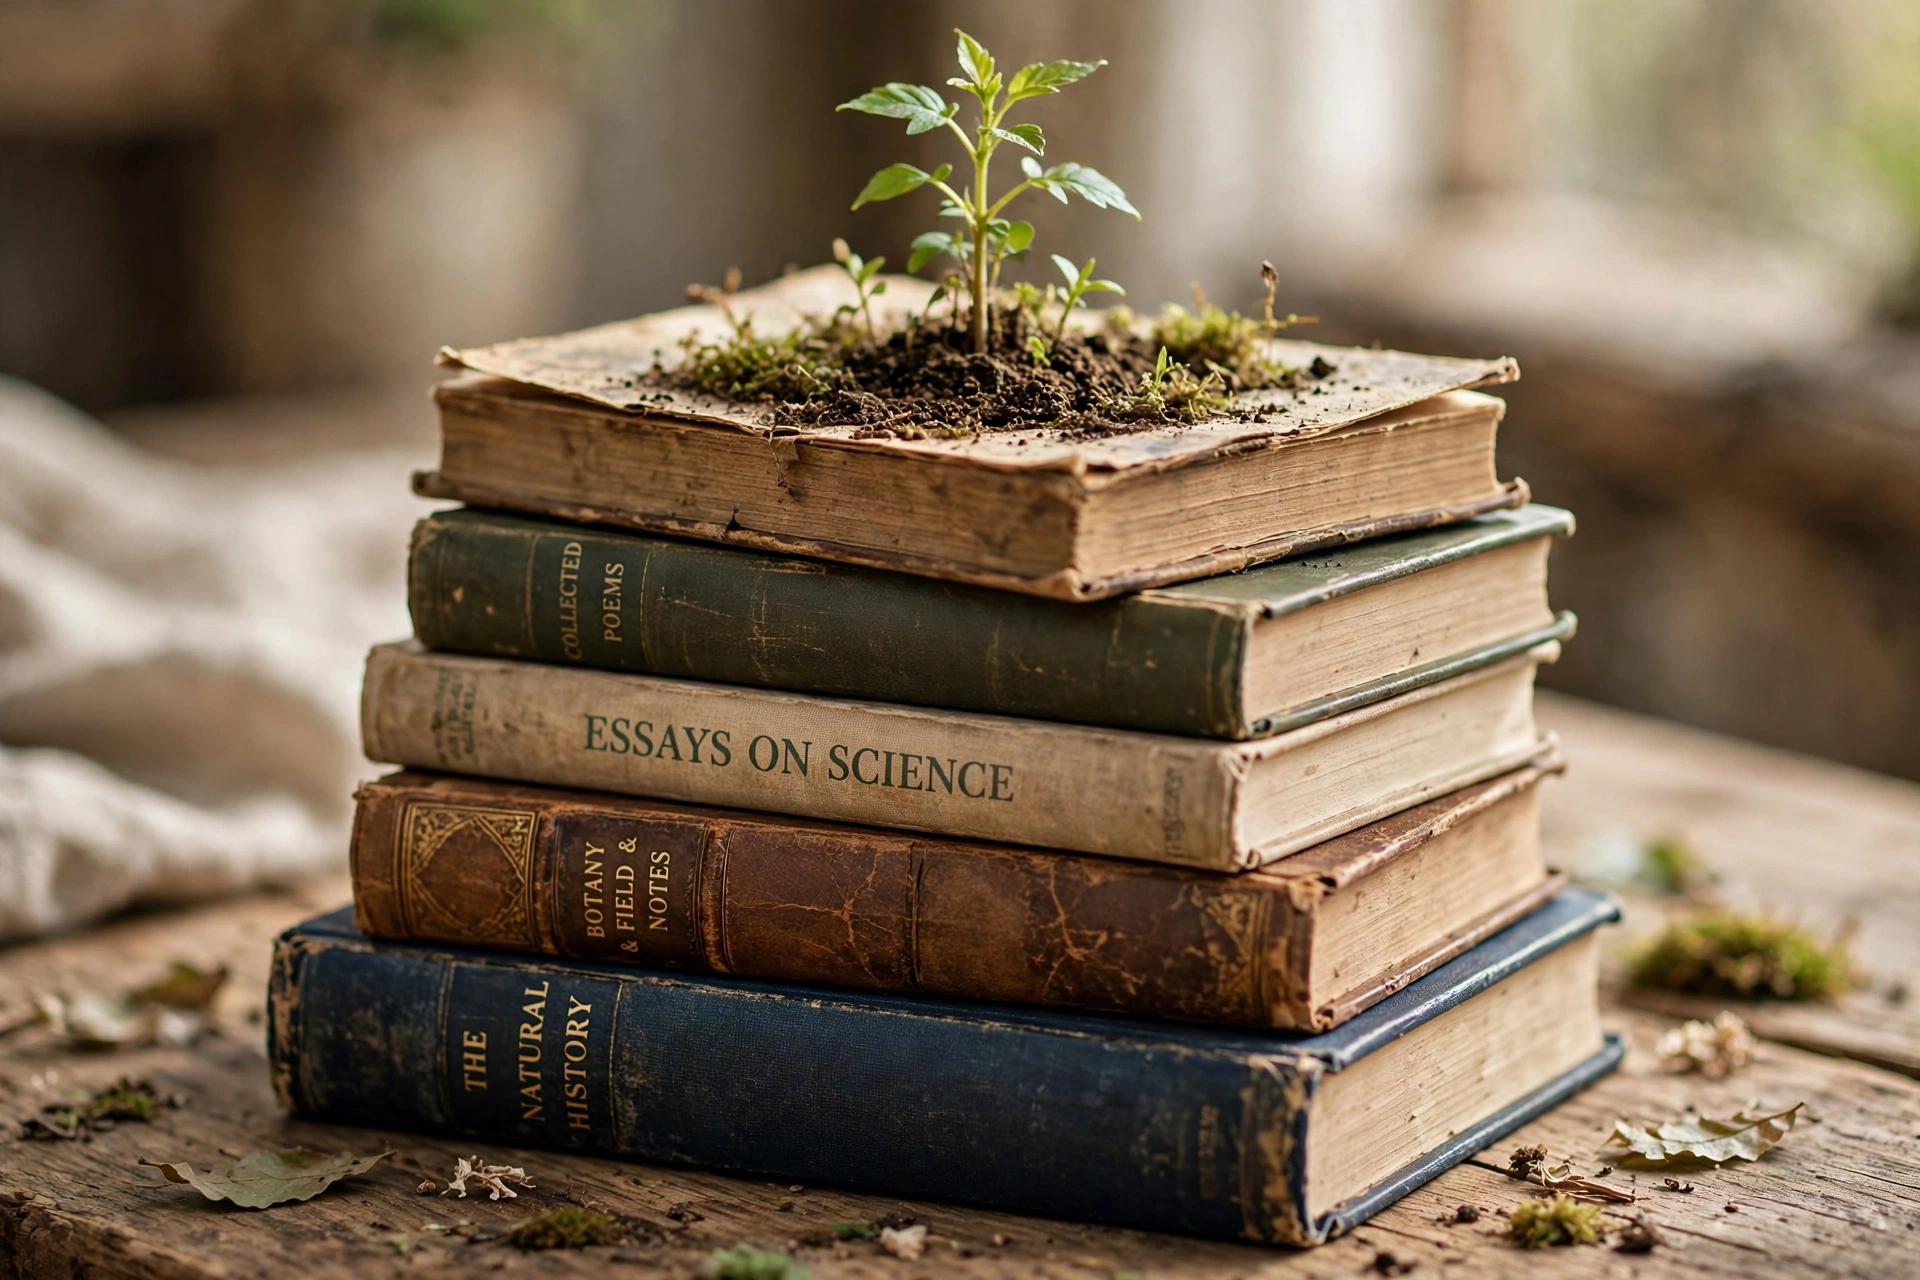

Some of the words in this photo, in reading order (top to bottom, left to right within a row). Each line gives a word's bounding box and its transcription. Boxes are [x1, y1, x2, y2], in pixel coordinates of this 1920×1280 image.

[559, 542, 582, 660] COLLECTED
[602, 563, 624, 642] POEMS
[583, 714, 732, 767] ESSAYS
[748, 735, 812, 777] ON
[828, 744, 1014, 802] SCIENCE
[618, 836, 637, 853] &
[583, 841, 605, 938] BOTANY
[615, 865, 635, 931] FIELD
[648, 851, 671, 931] NOTES
[620, 940, 639, 953] &
[462, 1030, 488, 1092] THE
[518, 980, 549, 1122] NATURAL
[564, 995, 592, 1131] HISTORY
